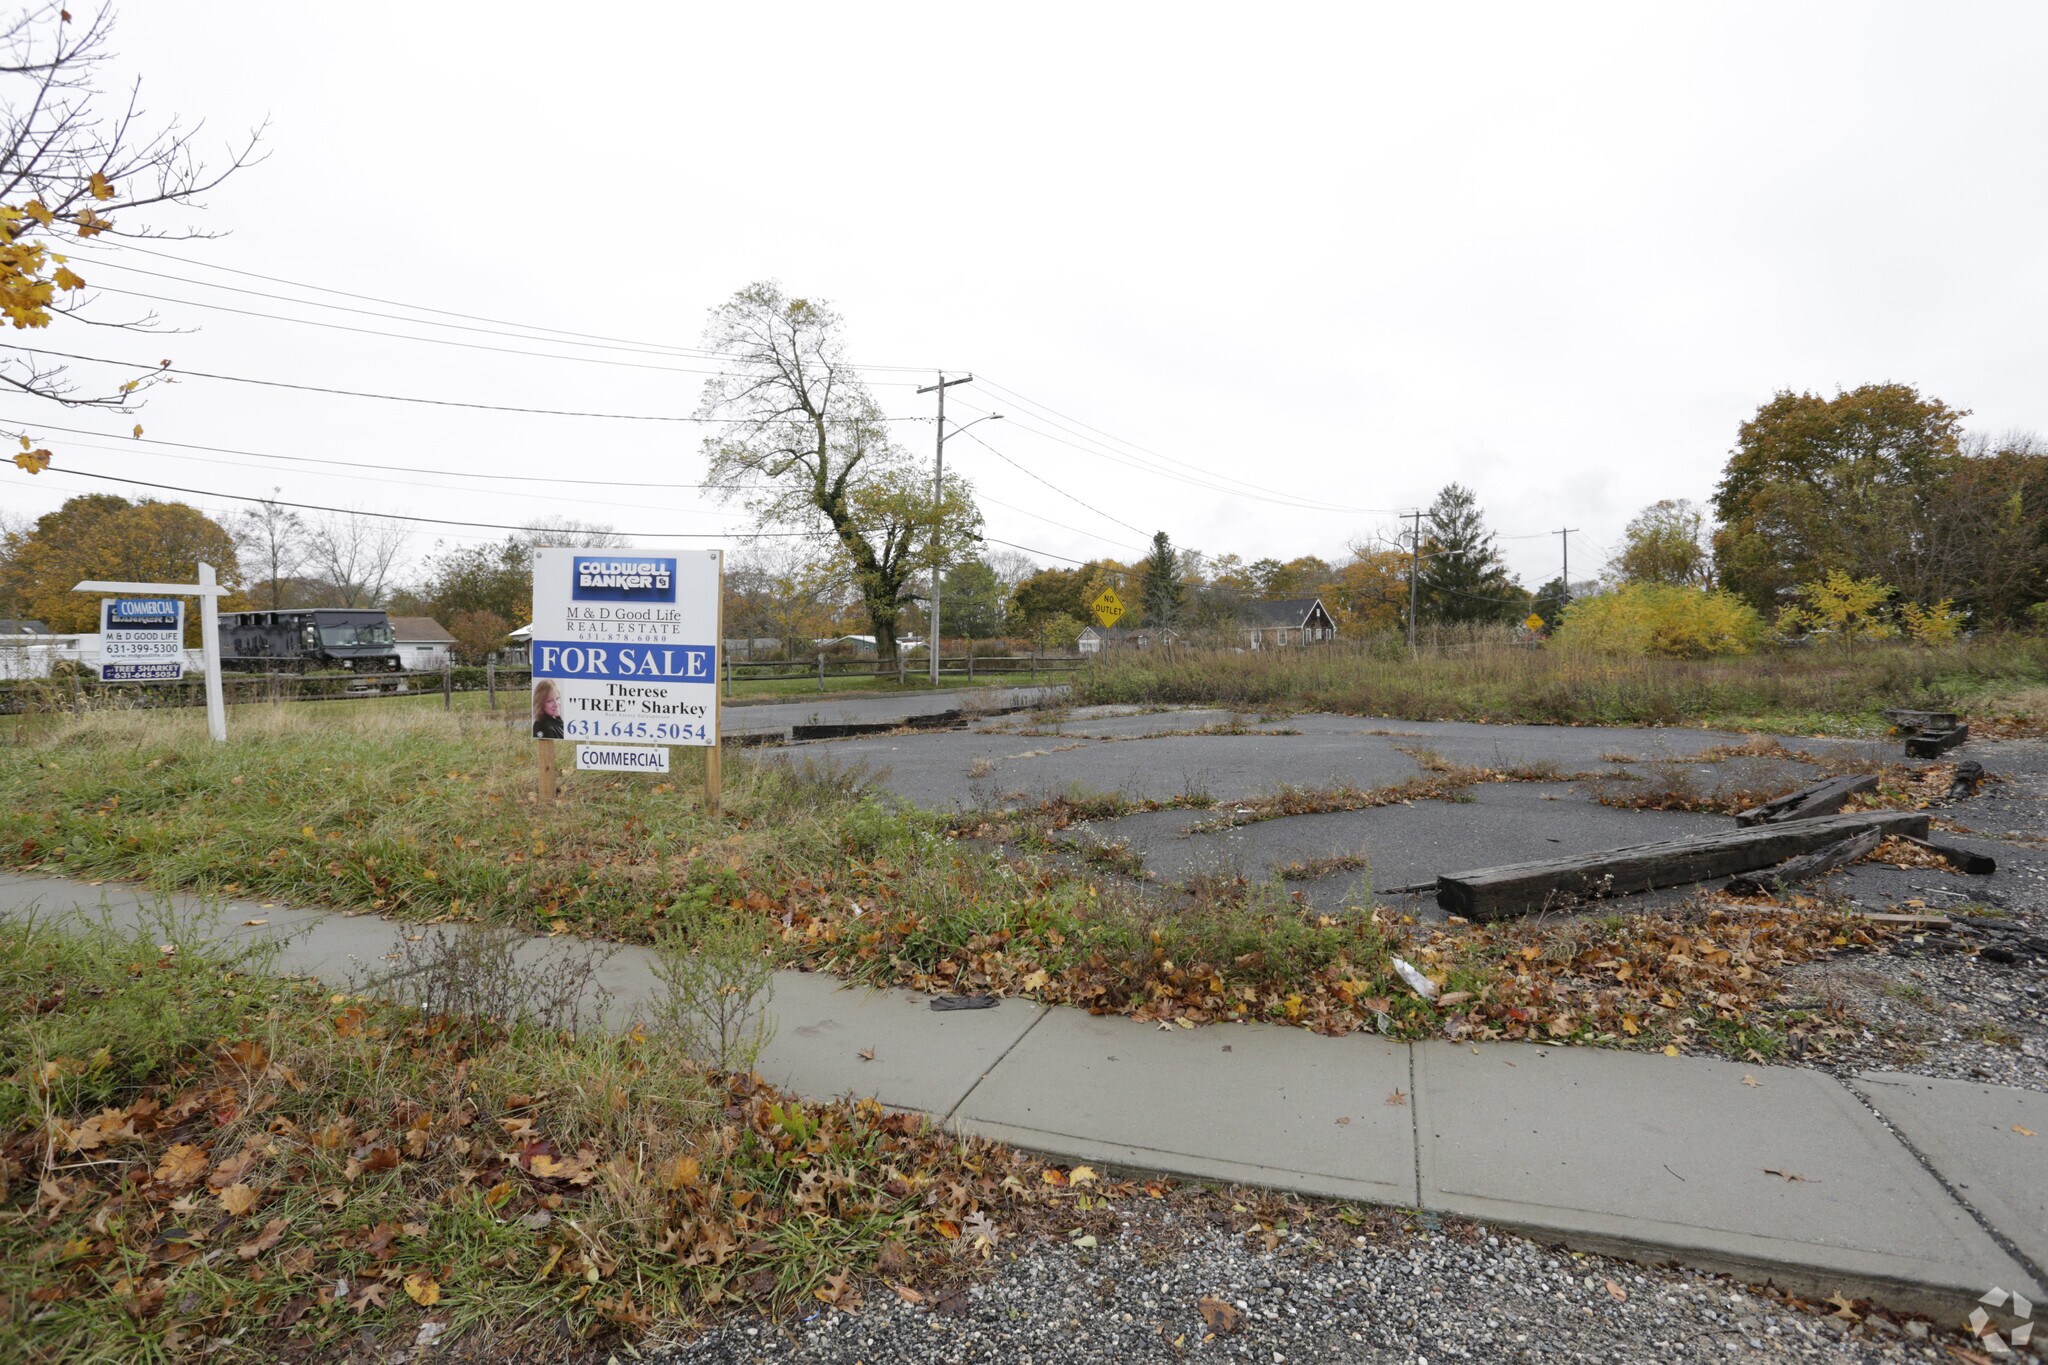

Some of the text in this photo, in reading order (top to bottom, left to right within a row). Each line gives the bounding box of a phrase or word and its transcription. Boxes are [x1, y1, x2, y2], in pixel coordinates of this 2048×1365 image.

[579, 562, 670, 575] COLDWELL
[580, 574, 653, 590] BANKER
[1104, 595, 1114, 603] NO
[121, 601, 174, 615] COMMERCIAL
[567, 607, 681, 621] M & D Good Life
[1096, 604, 1122, 615] OUTLET
[567, 622, 680, 634] REAL ESTATE
[579, 633, 667, 642] 631.878.6080
[106, 644, 178, 653] 631-399-5300
[540, 646, 707, 677] FOR SALE
[114, 671, 177, 679] 631-645-5054
[606, 683, 668, 698] Therese
[569, 697, 707, 718] "TREE" Sharkey
[567, 719, 706, 740] 631.645.5054
[582, 751, 664, 767] COMMERCIAL
